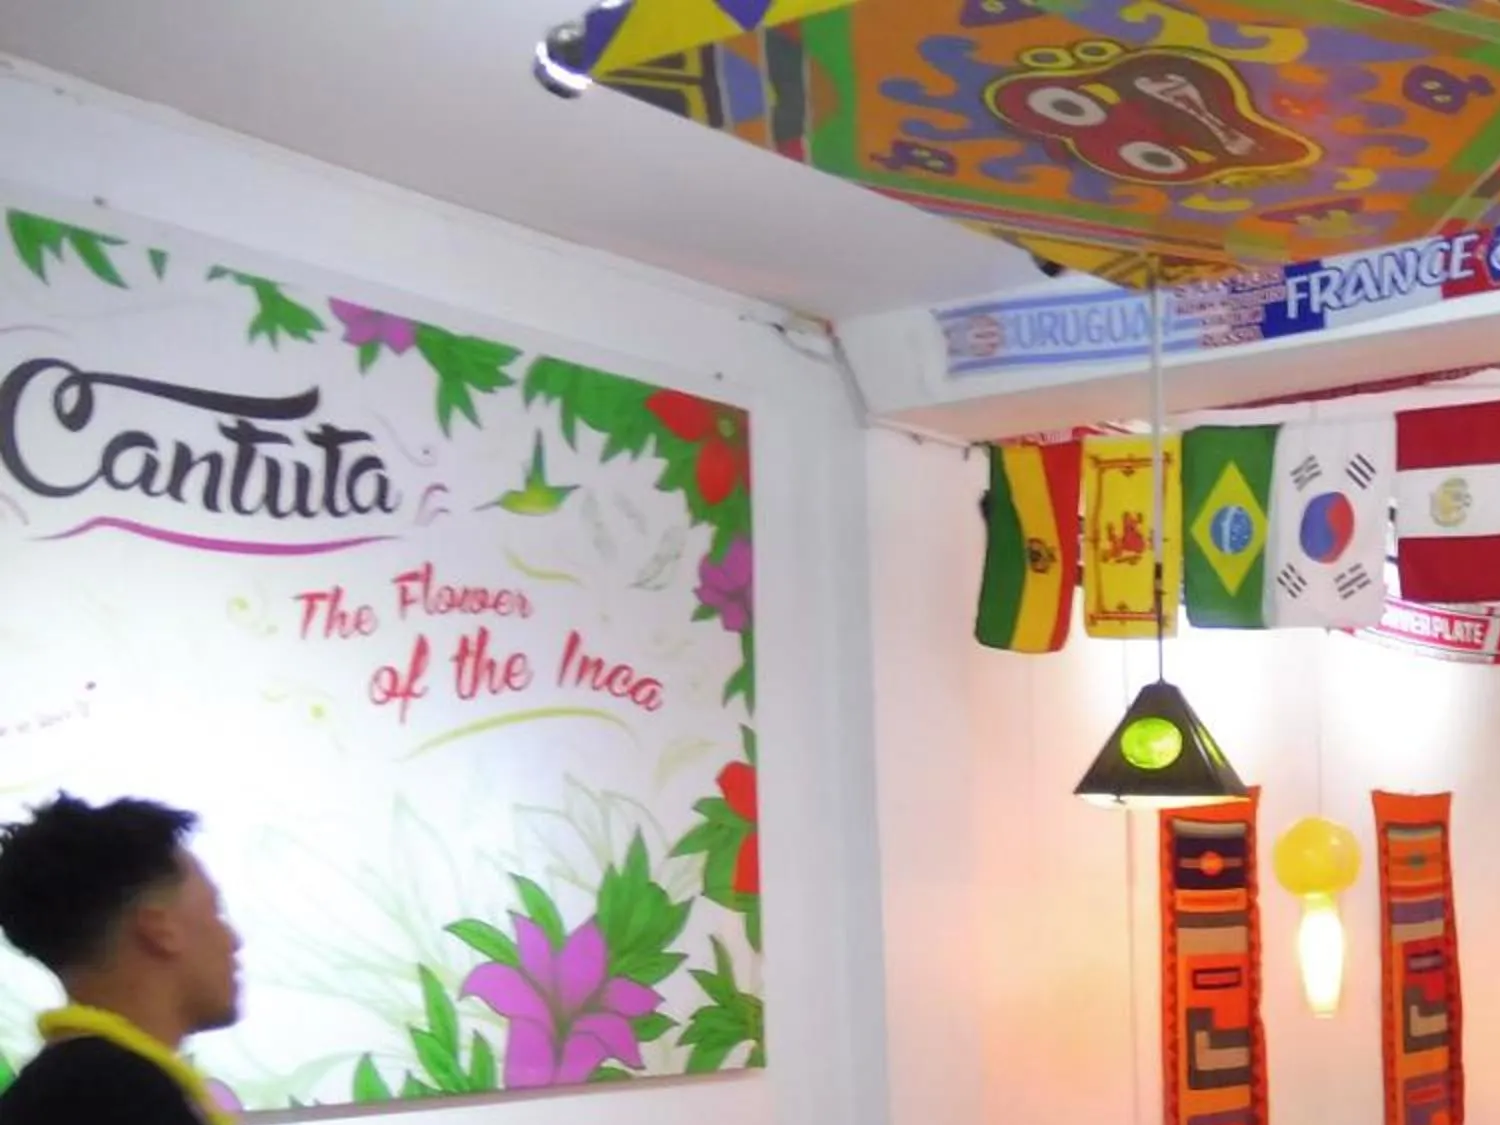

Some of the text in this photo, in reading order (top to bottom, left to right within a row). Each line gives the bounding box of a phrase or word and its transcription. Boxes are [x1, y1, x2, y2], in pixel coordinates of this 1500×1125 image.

[1285, 229, 1481, 319] FRANCE
[0, 357, 400, 520] Cantuta
[293, 561, 534, 640] The Flower
[368, 626, 664, 724] of the Inca
